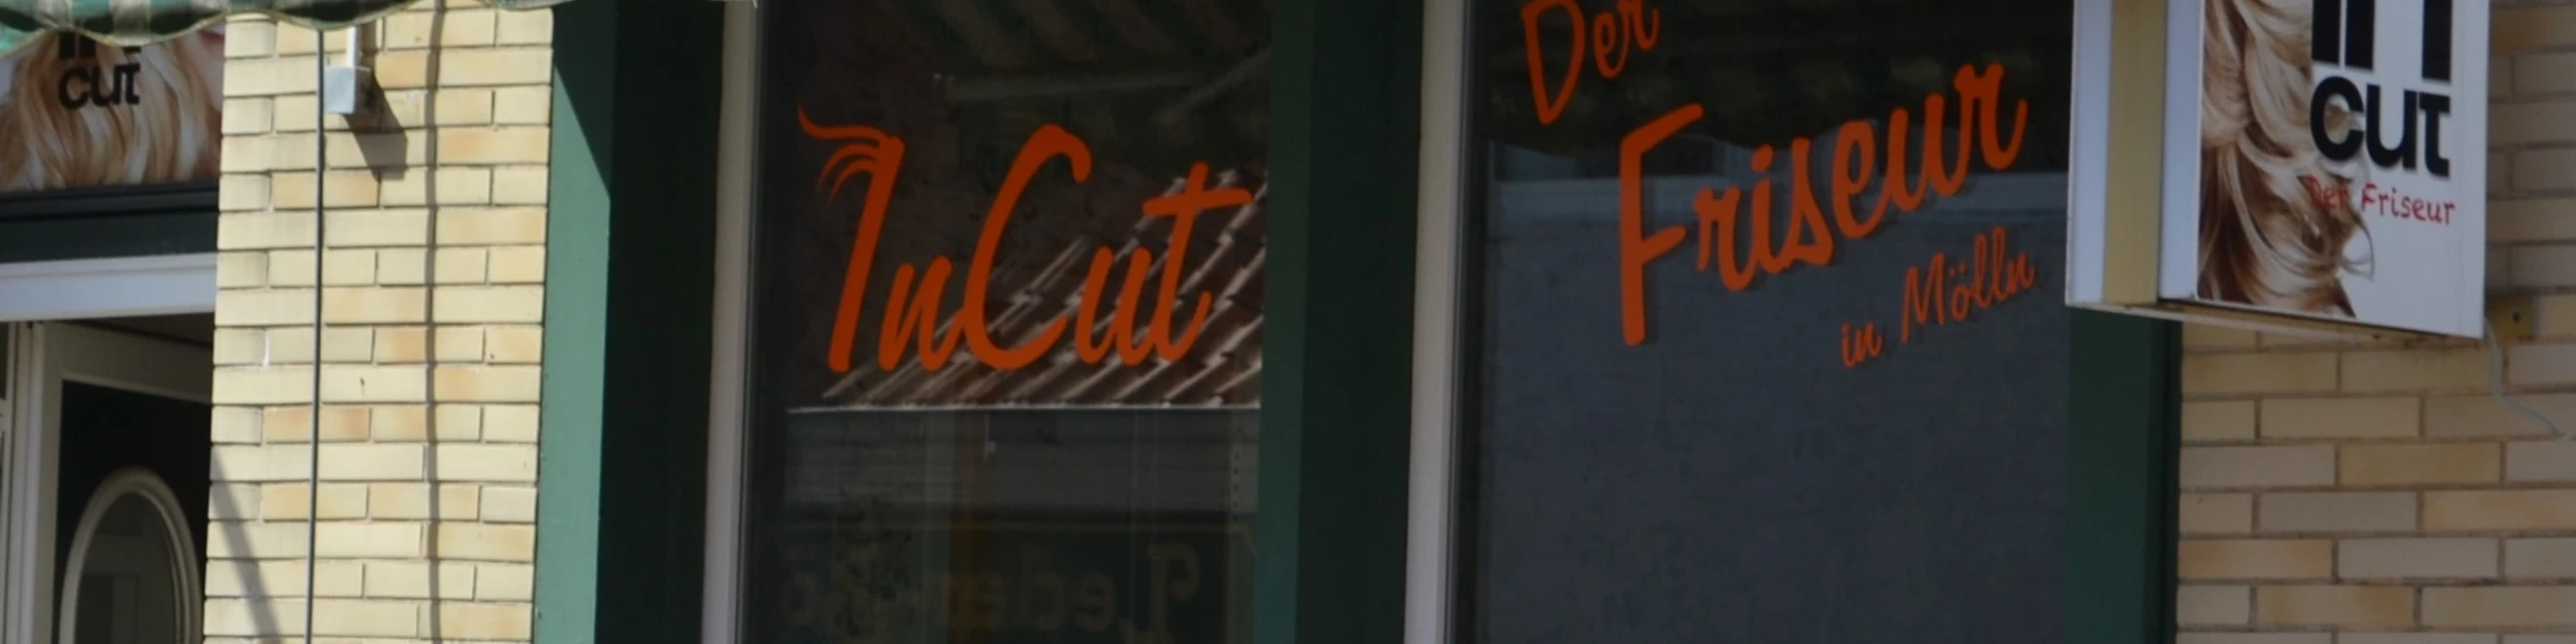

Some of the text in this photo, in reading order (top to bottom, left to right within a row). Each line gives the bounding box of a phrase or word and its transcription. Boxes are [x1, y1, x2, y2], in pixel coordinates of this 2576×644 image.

[1521, 0, 1658, 125] Der
[798, 101, 1254, 374] InCut
[1620, 63, 2028, 345] Friseur
[2307, 174, 2456, 226] Der Friseur
[1841, 225, 2036, 369] in Mölln
